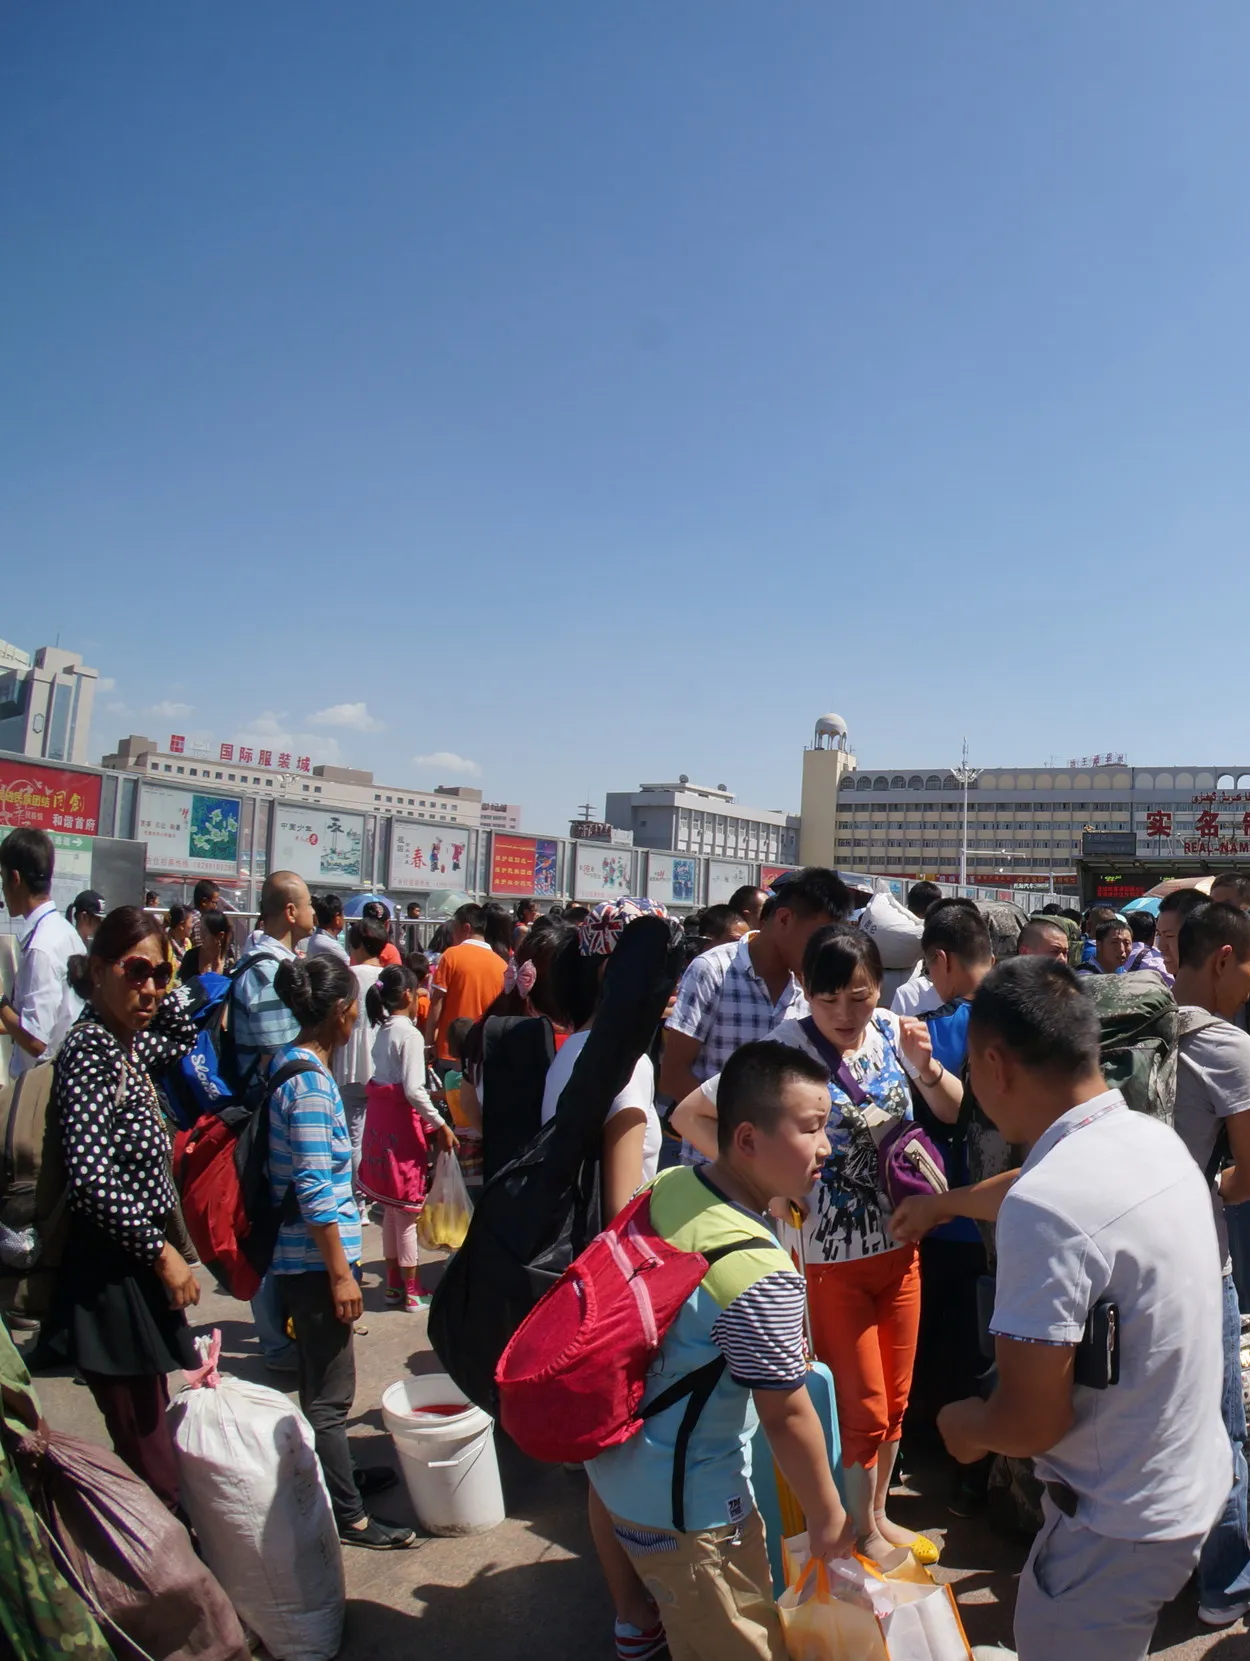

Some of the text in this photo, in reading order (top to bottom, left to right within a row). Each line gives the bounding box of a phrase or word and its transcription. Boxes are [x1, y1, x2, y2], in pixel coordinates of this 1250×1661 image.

[219, 743, 312, 773] 国际服装城
[411, 846, 427, 869] 春
